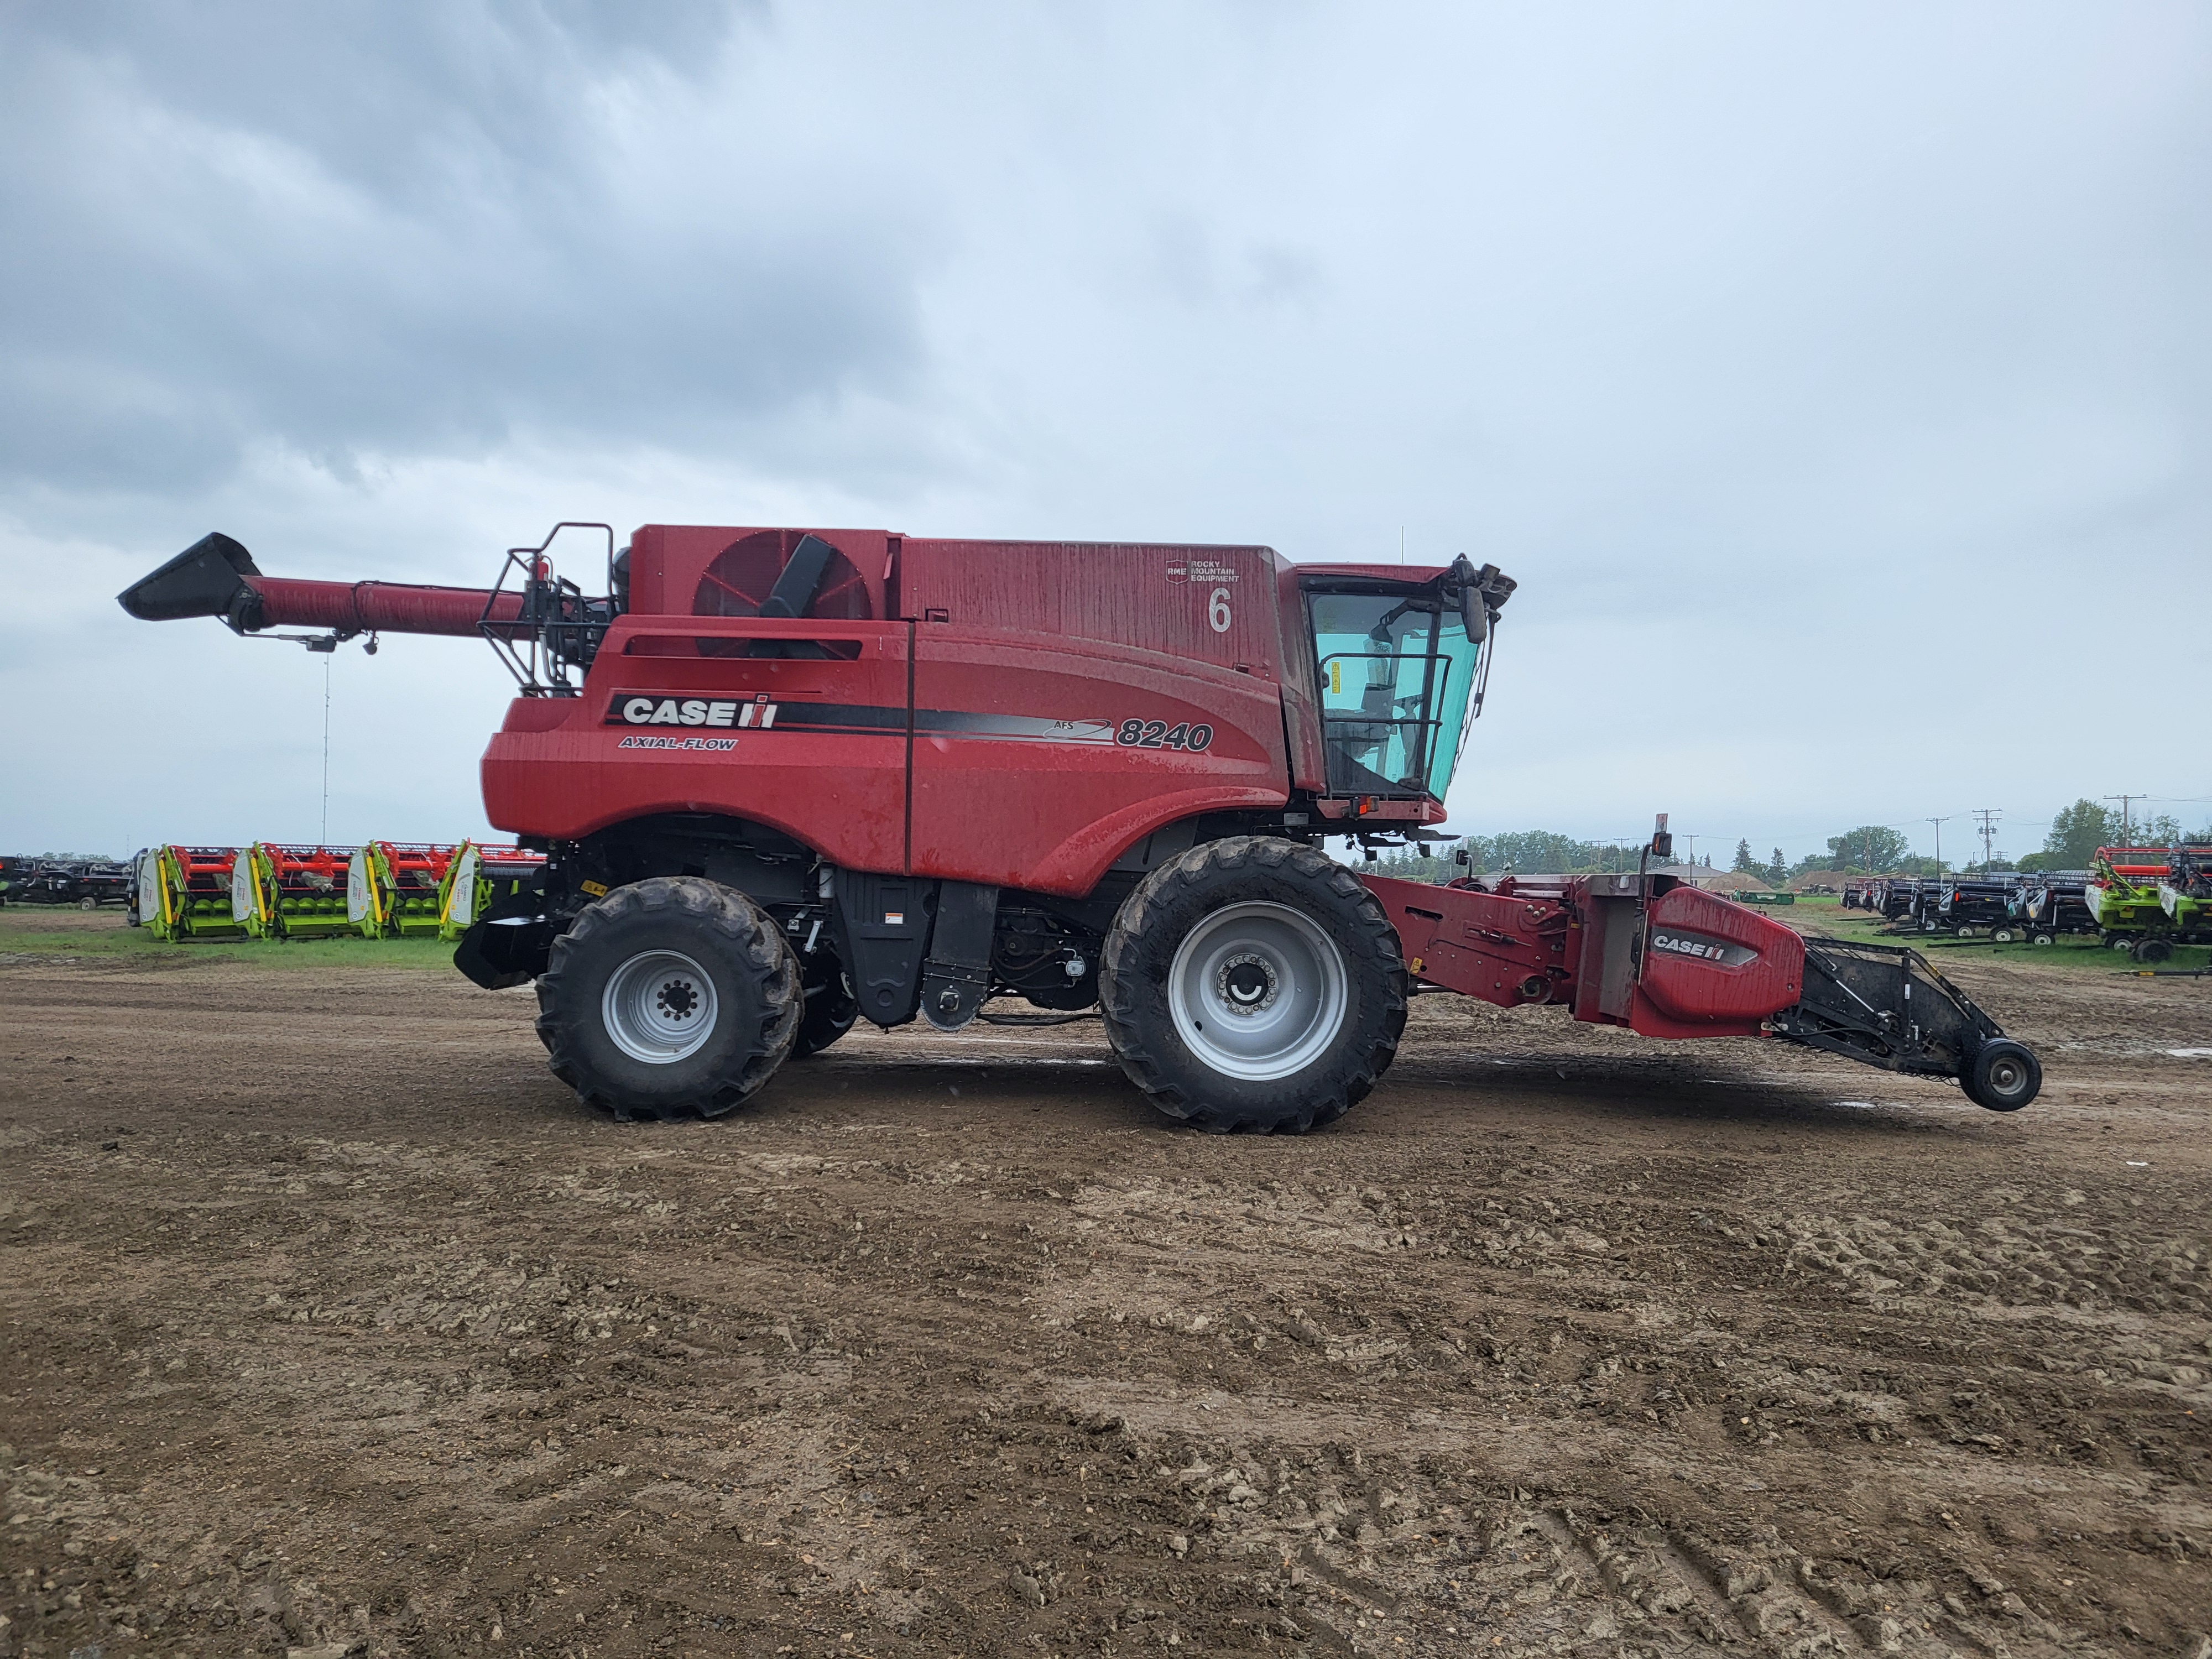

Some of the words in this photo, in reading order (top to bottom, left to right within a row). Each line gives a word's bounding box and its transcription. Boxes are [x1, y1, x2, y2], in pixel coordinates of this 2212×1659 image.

[1167, 567, 1187, 576] RME
[1191, 575, 1240, 583] EQUIPMENT
[1208, 587, 1232, 633] 6
[622, 698, 737, 727] CASE
[1053, 720, 1074, 730] AFS
[618, 735, 739, 751] AXIAL-FLOW
[1116, 718, 1214, 752] 8240
[1653, 935, 1706, 956] CASE
